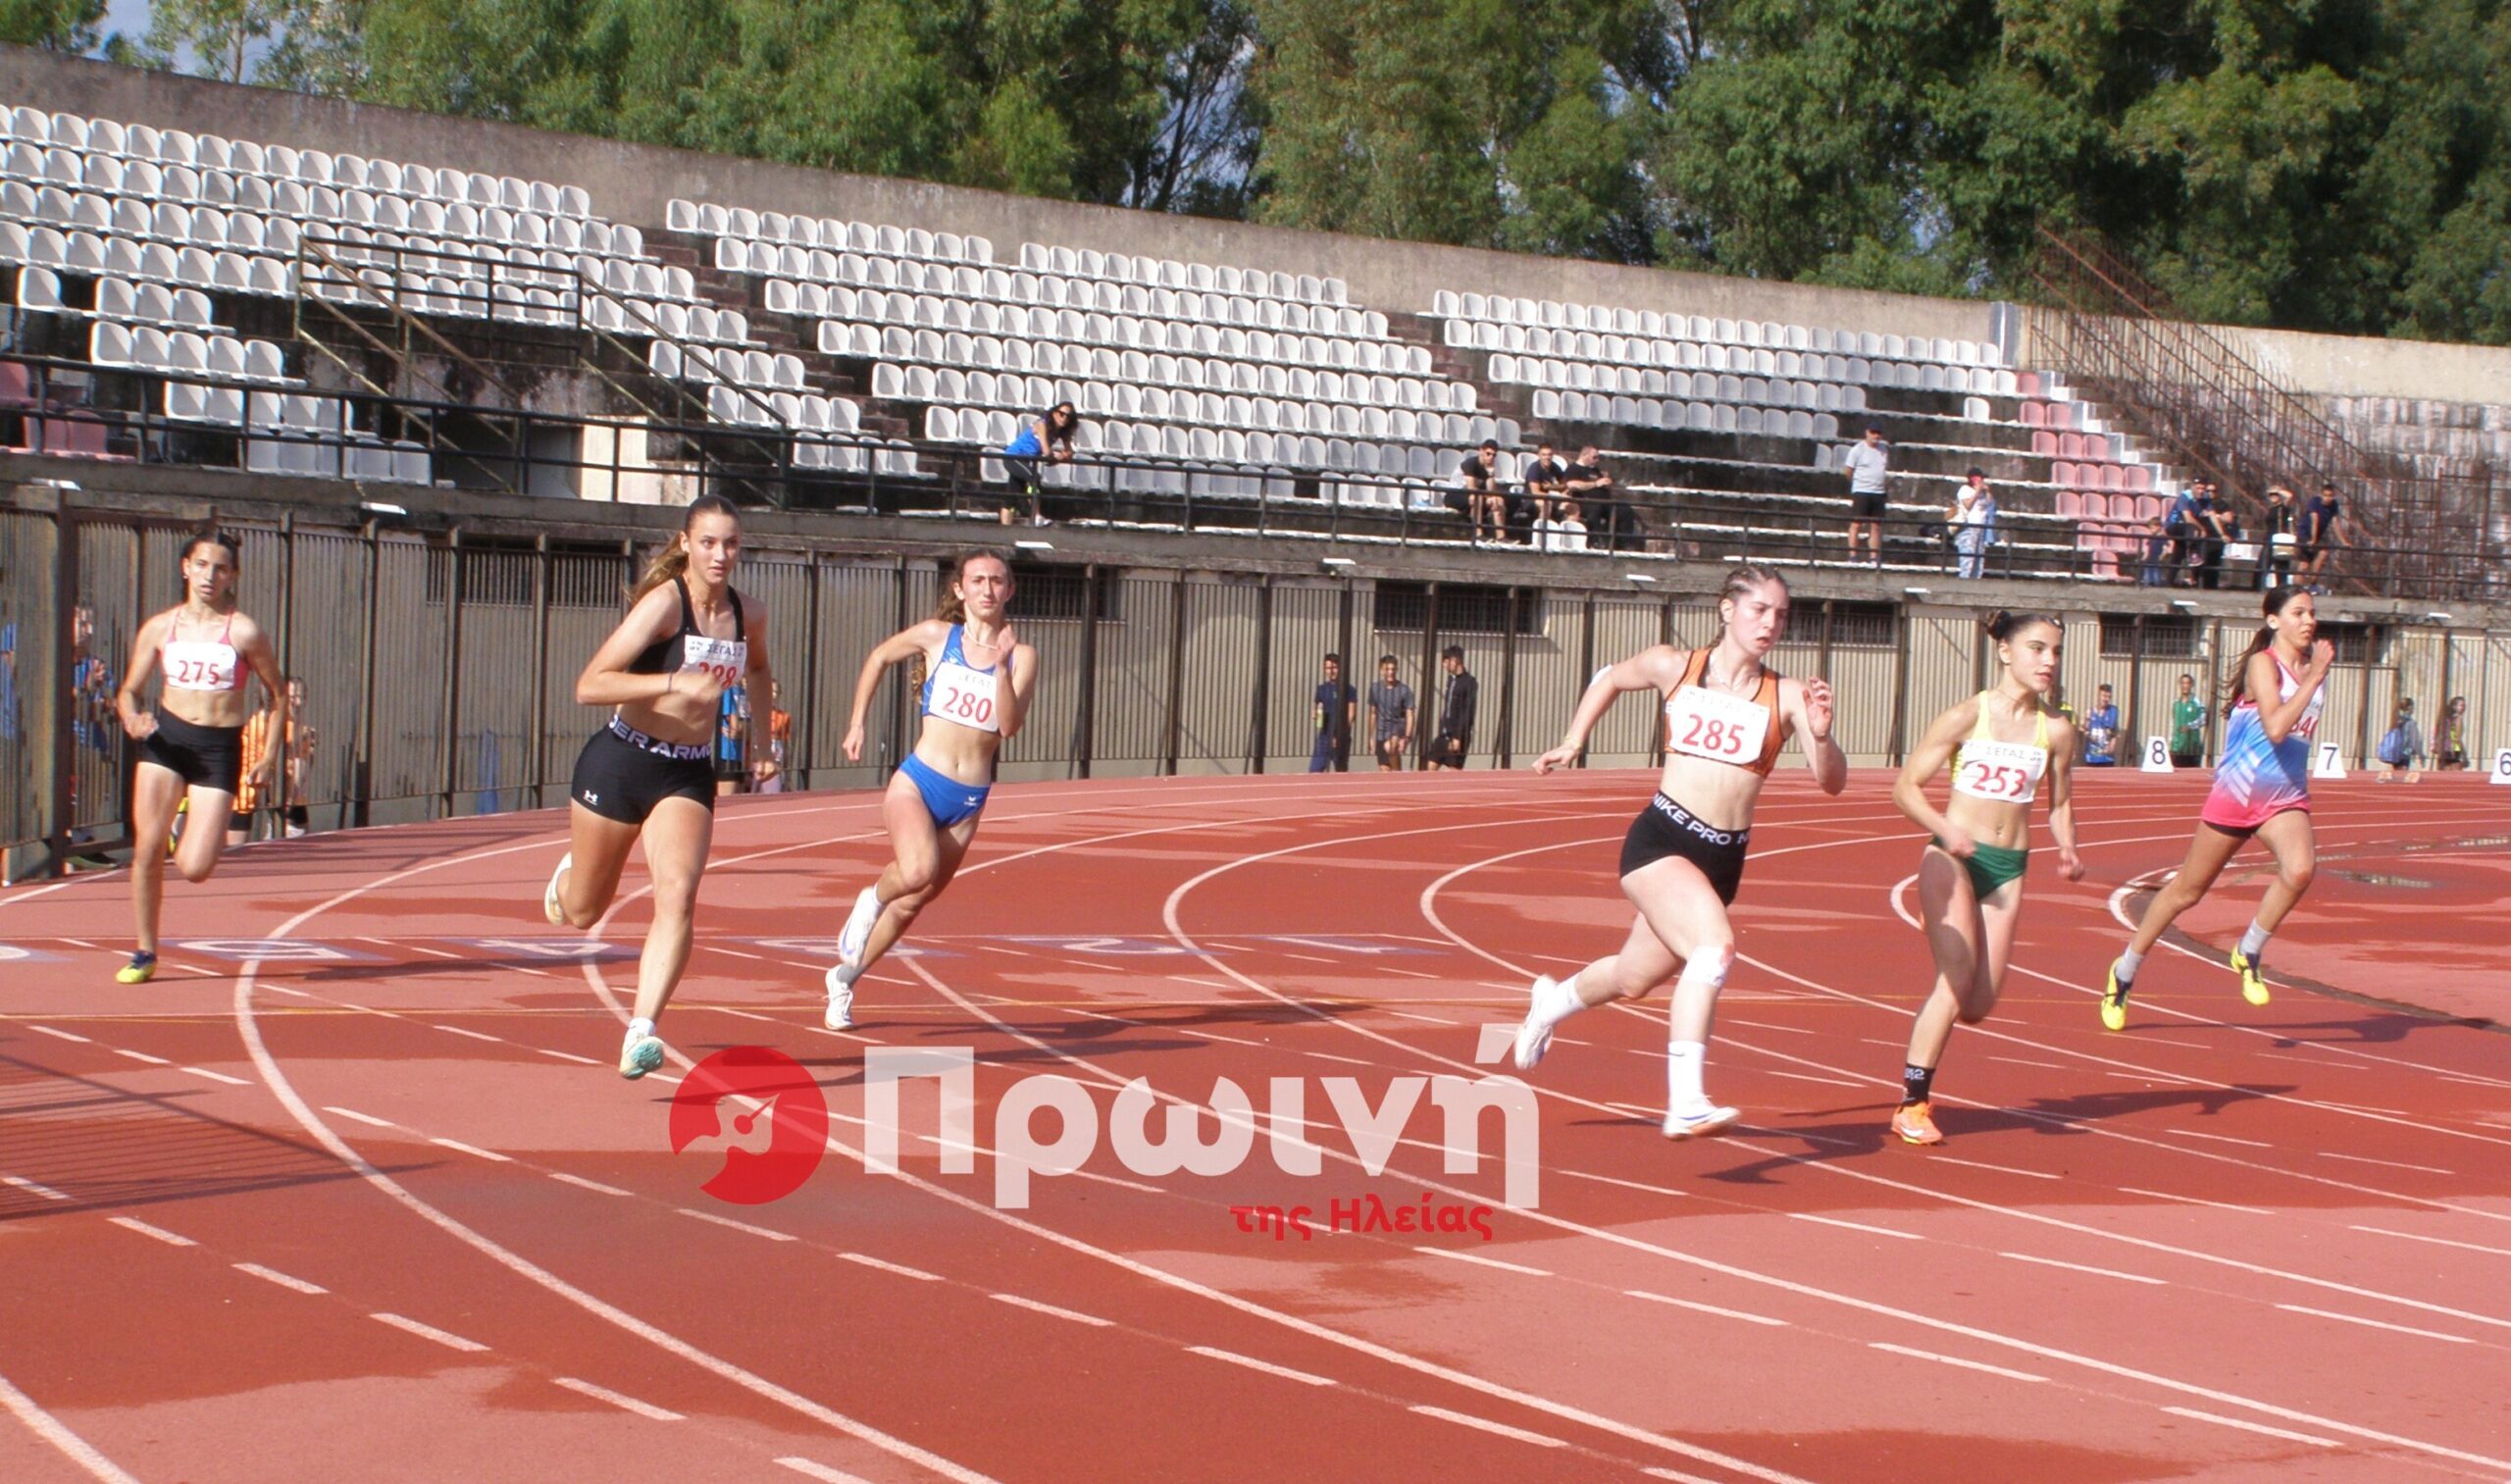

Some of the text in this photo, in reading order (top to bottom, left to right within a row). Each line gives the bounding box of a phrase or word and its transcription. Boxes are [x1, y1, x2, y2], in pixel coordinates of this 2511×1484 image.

[179, 660, 220, 685] 275
[943, 687, 992, 723] 280
[1682, 714, 1745, 754] 285
[2152, 741, 2166, 765] 8
[2323, 746, 2337, 770] 7
[2500, 752, 2511, 776] 6
[1972, 763, 2027, 796] 253
[1653, 793, 1690, 825] NIKE
[1686, 820, 1731, 845] PRO
[1007, 938, 1185, 953] 2
